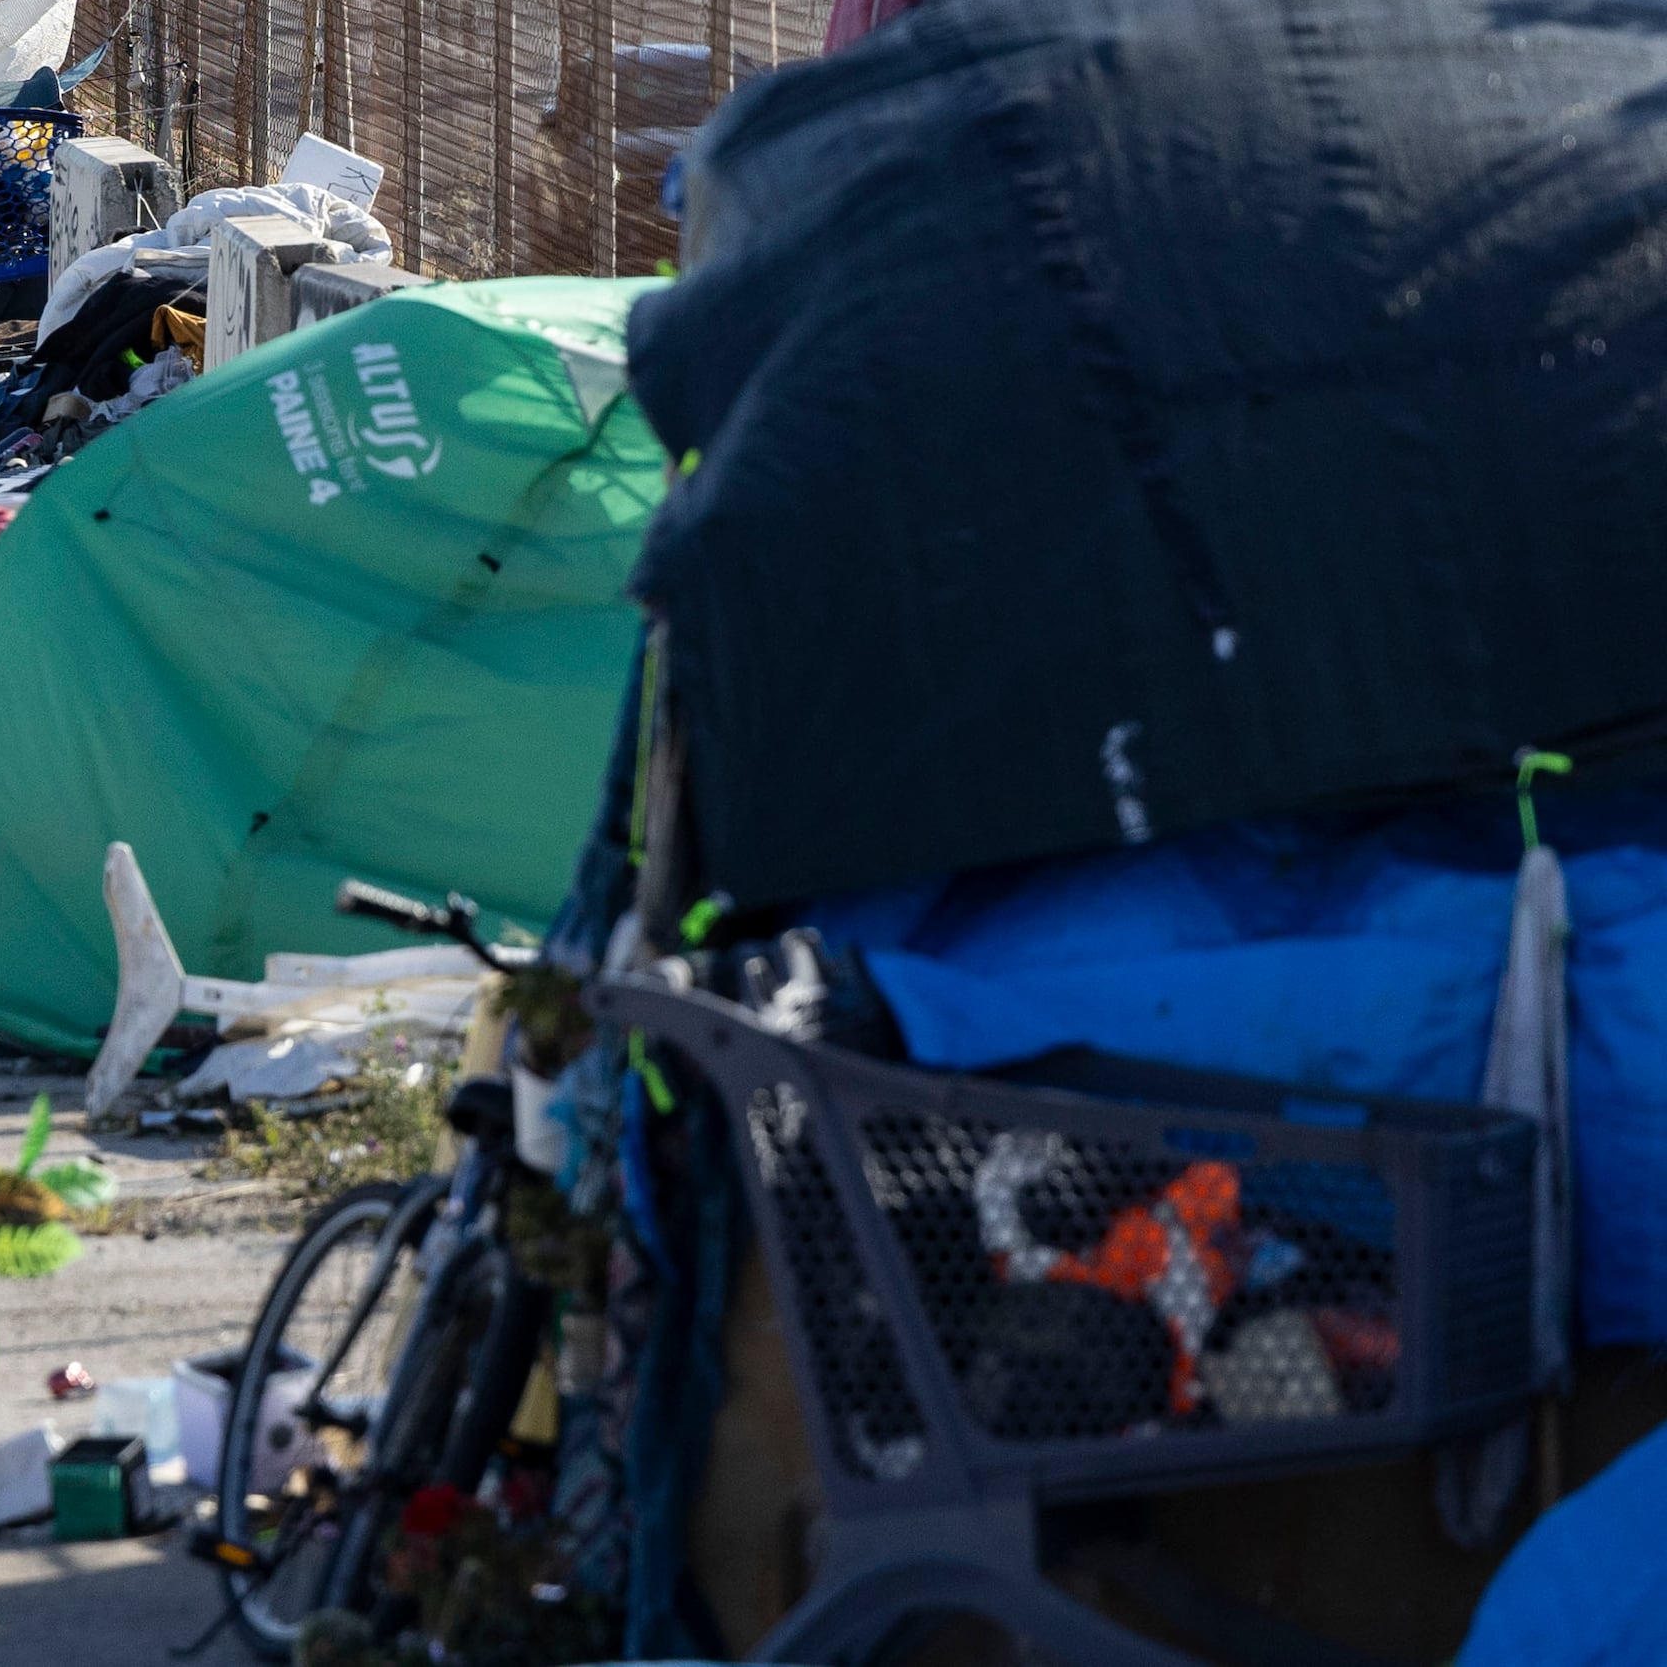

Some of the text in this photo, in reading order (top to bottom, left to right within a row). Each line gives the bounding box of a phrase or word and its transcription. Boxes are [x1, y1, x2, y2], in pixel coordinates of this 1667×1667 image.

[266, 370, 341, 505] PAINE 4
[351, 343, 429, 479] ALTUS
